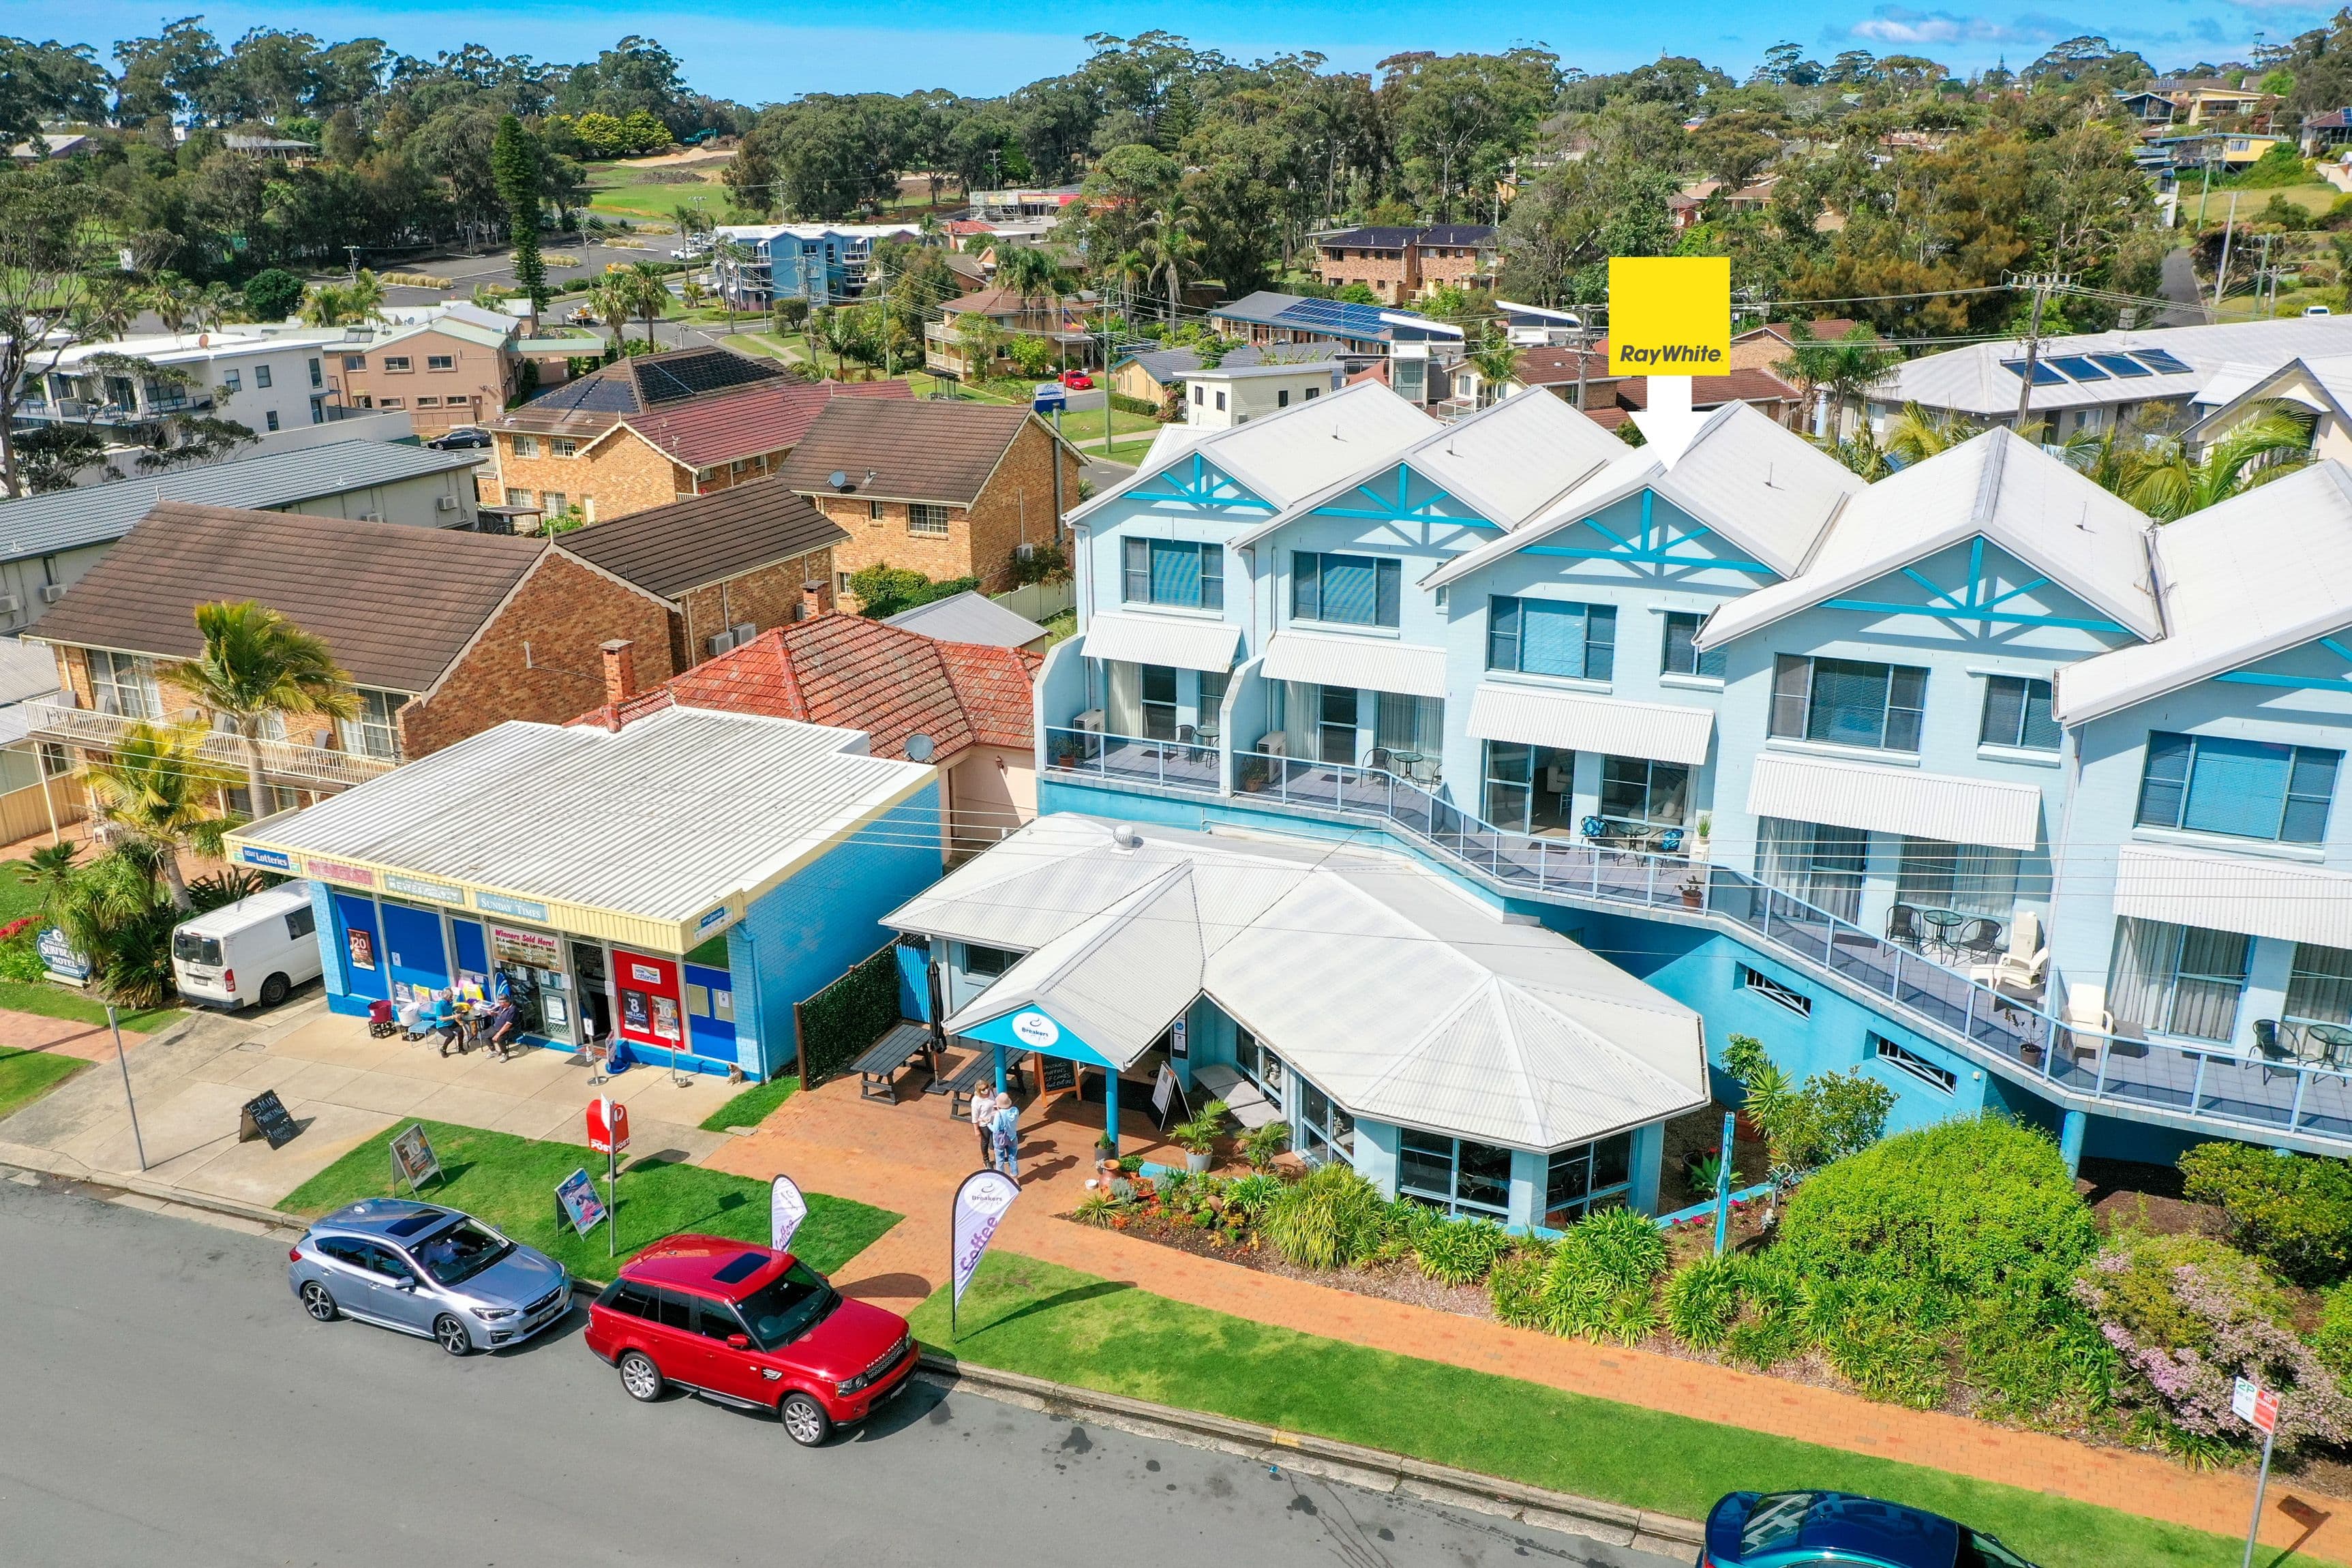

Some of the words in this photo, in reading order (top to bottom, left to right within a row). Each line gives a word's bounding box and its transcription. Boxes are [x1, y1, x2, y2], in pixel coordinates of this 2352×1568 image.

[256, 852, 288, 866] Lotteries
[495, 929, 519, 940] Winners
[522, 934, 535, 944] Sold
[537, 937, 555, 947] Here!
[52, 956, 77, 967] MOTEL
[1021, 1027, 1049, 1037] Breakers
[258, 1096, 278, 1111] MIN
[256, 1105, 285, 1126] PARKING
[960, 1217, 998, 1273] Coffee
[2238, 1380, 2255, 1393] 2P
